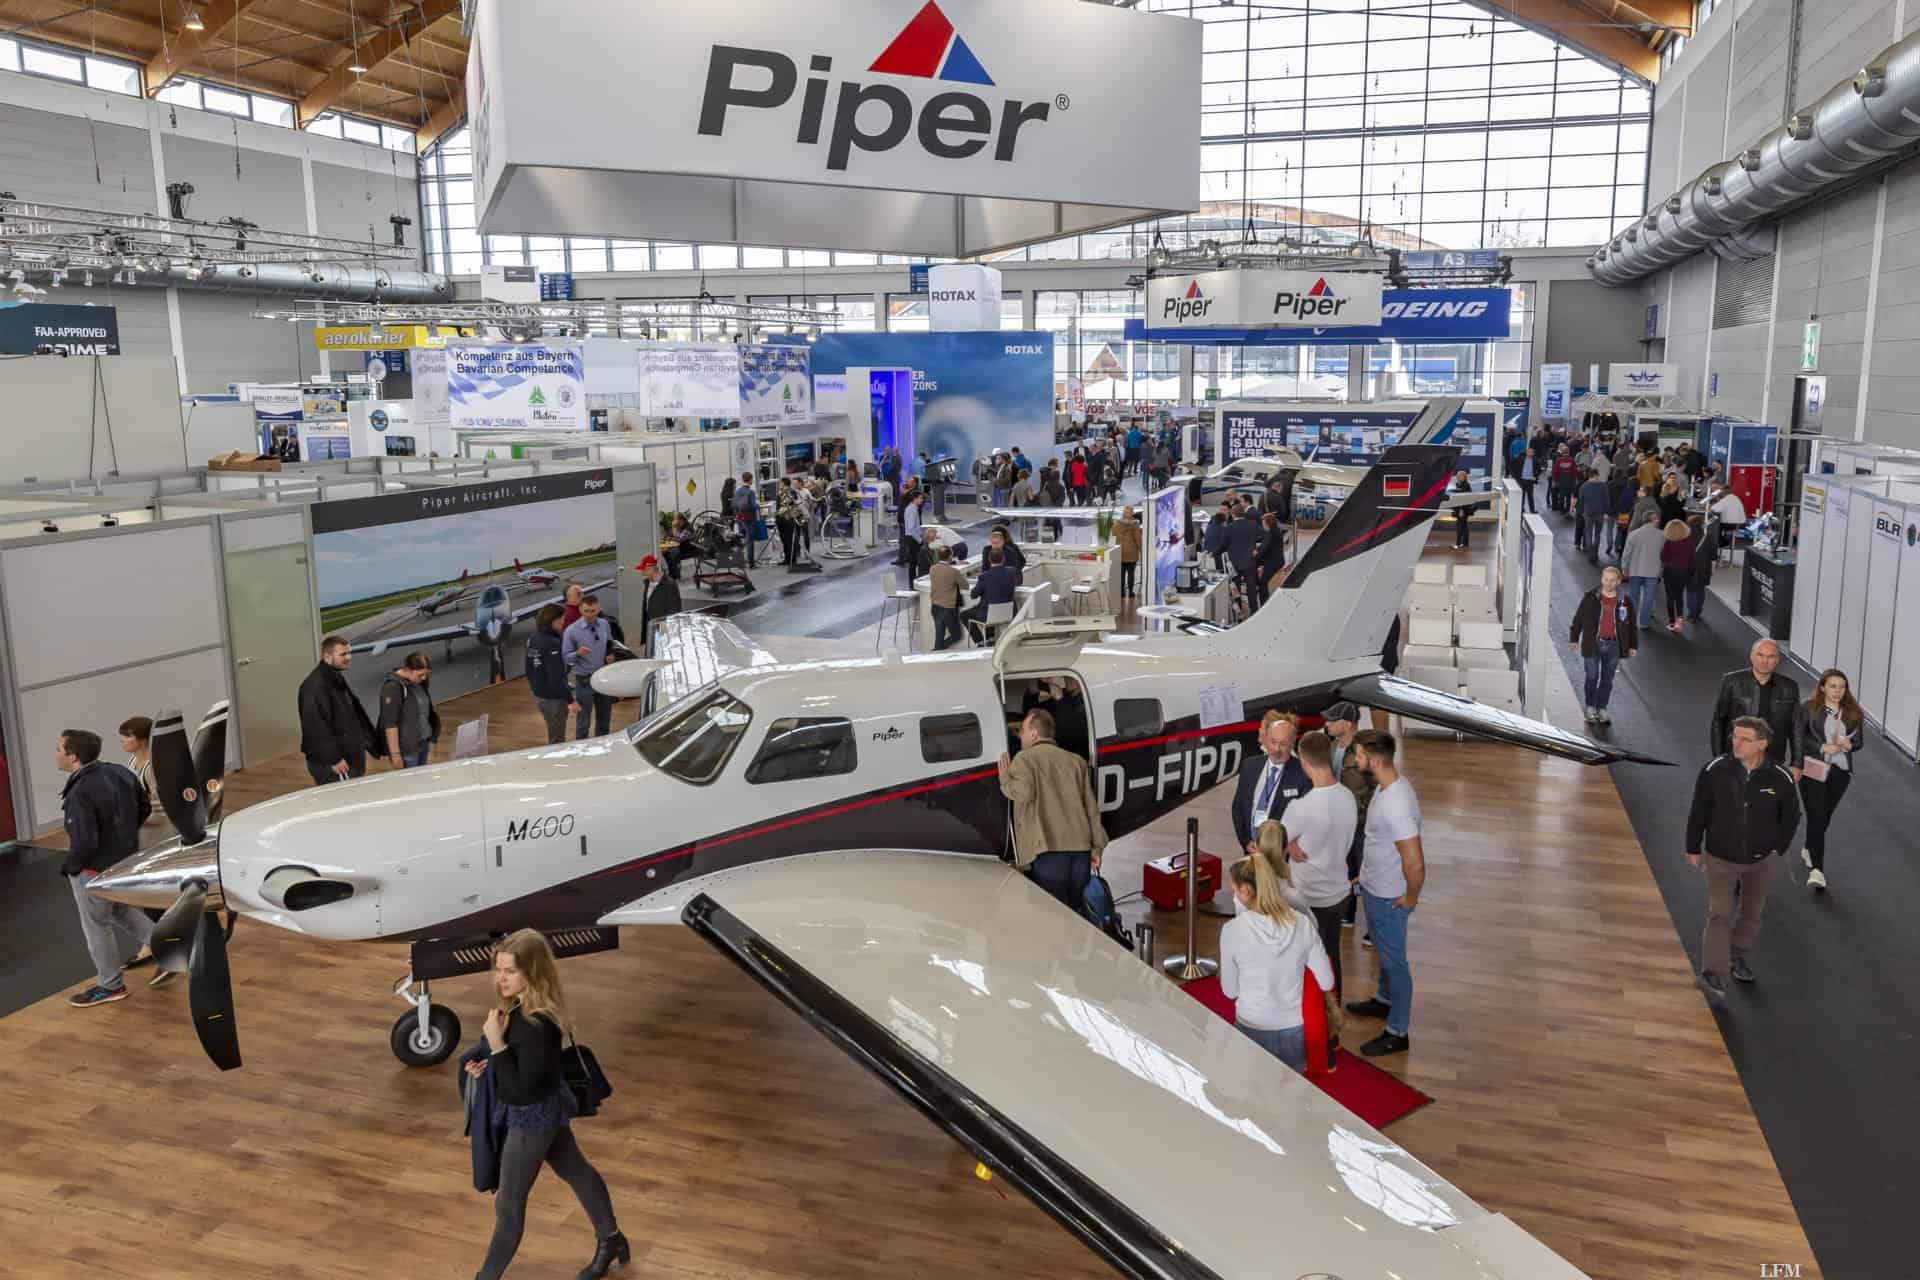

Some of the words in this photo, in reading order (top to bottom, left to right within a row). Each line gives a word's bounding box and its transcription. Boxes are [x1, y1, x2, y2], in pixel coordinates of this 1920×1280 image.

[1442, 252, 1465, 266] A3
[931, 290, 976, 302] ROTAX
[1163, 297, 1212, 322] Piper
[1273, 292, 1347, 320] Piper
[1382, 301, 1488, 318] OEING
[34, 326, 107, 338] FAA-APPROVED
[1005, 345, 1043, 355] ROTAX
[456, 351, 513, 363] Kompetenz
[515, 352, 534, 361] aus
[537, 350, 575, 363] Bayern
[457, 363, 503, 374] Bavarian
[912, 371, 925, 380] ER
[913, 381, 937, 391] ZONS
[1229, 417, 1256, 428] THE
[1230, 428, 1281, 438] FUTURE
[1229, 438, 1242, 448] IS
[584, 479, 607, 491] Piper
[422, 496, 457, 509] Piper
[521, 484, 542, 495] Inc.
[1876, 517, 1902, 536] BLR
[872, 731, 905, 741] Piper
[1098, 740, 1242, 812] D-FIPD
[506, 814, 575, 842] M600
